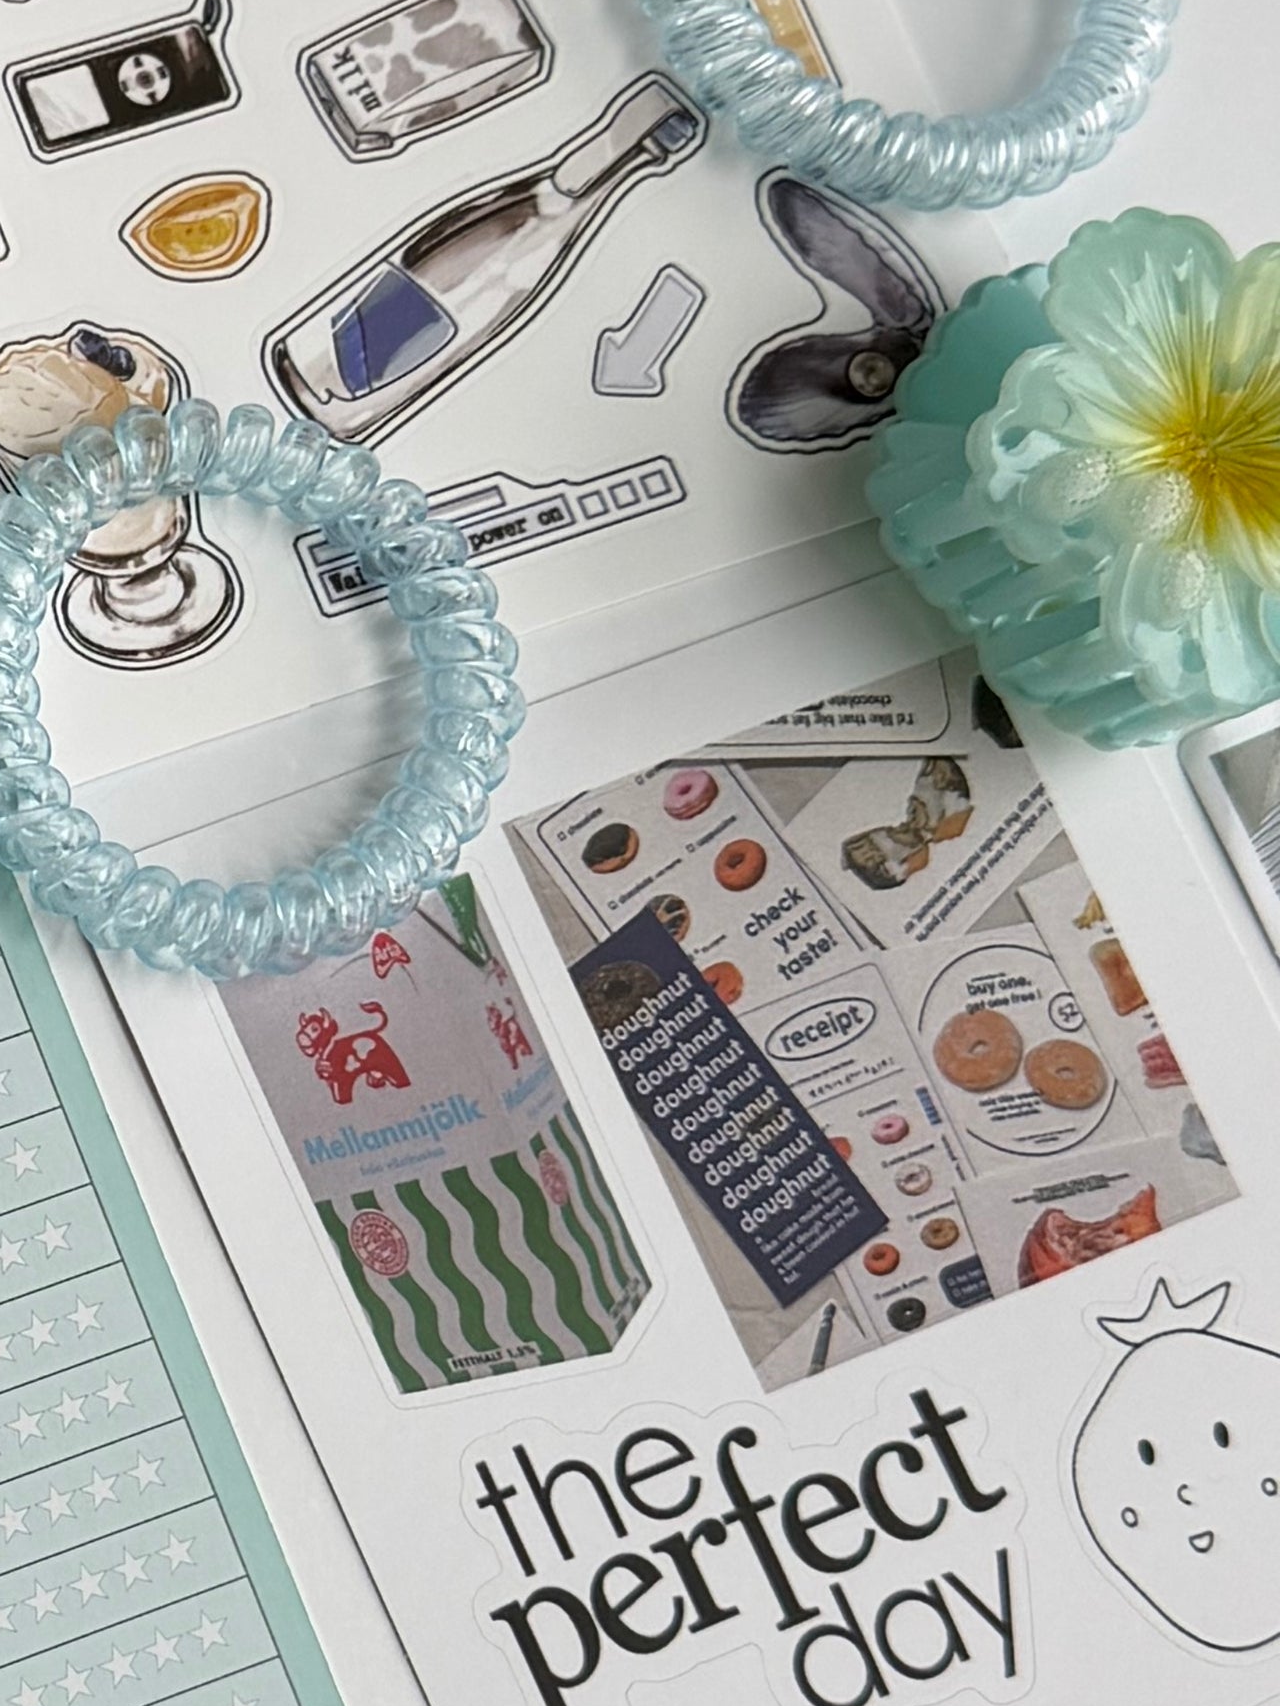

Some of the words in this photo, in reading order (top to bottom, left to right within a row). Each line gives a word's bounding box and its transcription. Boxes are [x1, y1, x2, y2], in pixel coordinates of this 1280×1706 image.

[332, 45, 382, 113] milk
[468, 517, 527, 552] power
[537, 506, 565, 526] on
[744, 887, 805, 937] check
[773, 908, 818, 952] your
[777, 929, 838, 981] taste!
[966, 981, 995, 996] buy
[602, 972, 693, 1049] doughnut
[619, 994, 710, 1072] doughnut
[780, 1005, 864, 1053] receipt
[637, 1017, 728, 1095] doughnut
[654, 1039, 745, 1118] doughnut
[303, 1093, 486, 1165] Mellanmjölk
[671, 1062, 762, 1141] doughnut
[688, 1085, 780, 1164] doughnut
[706, 1107, 797, 1188] doughnut
[723, 1130, 814, 1211] doughnut
[740, 1153, 832, 1234] doughnut
[476, 1427, 702, 1576] the
